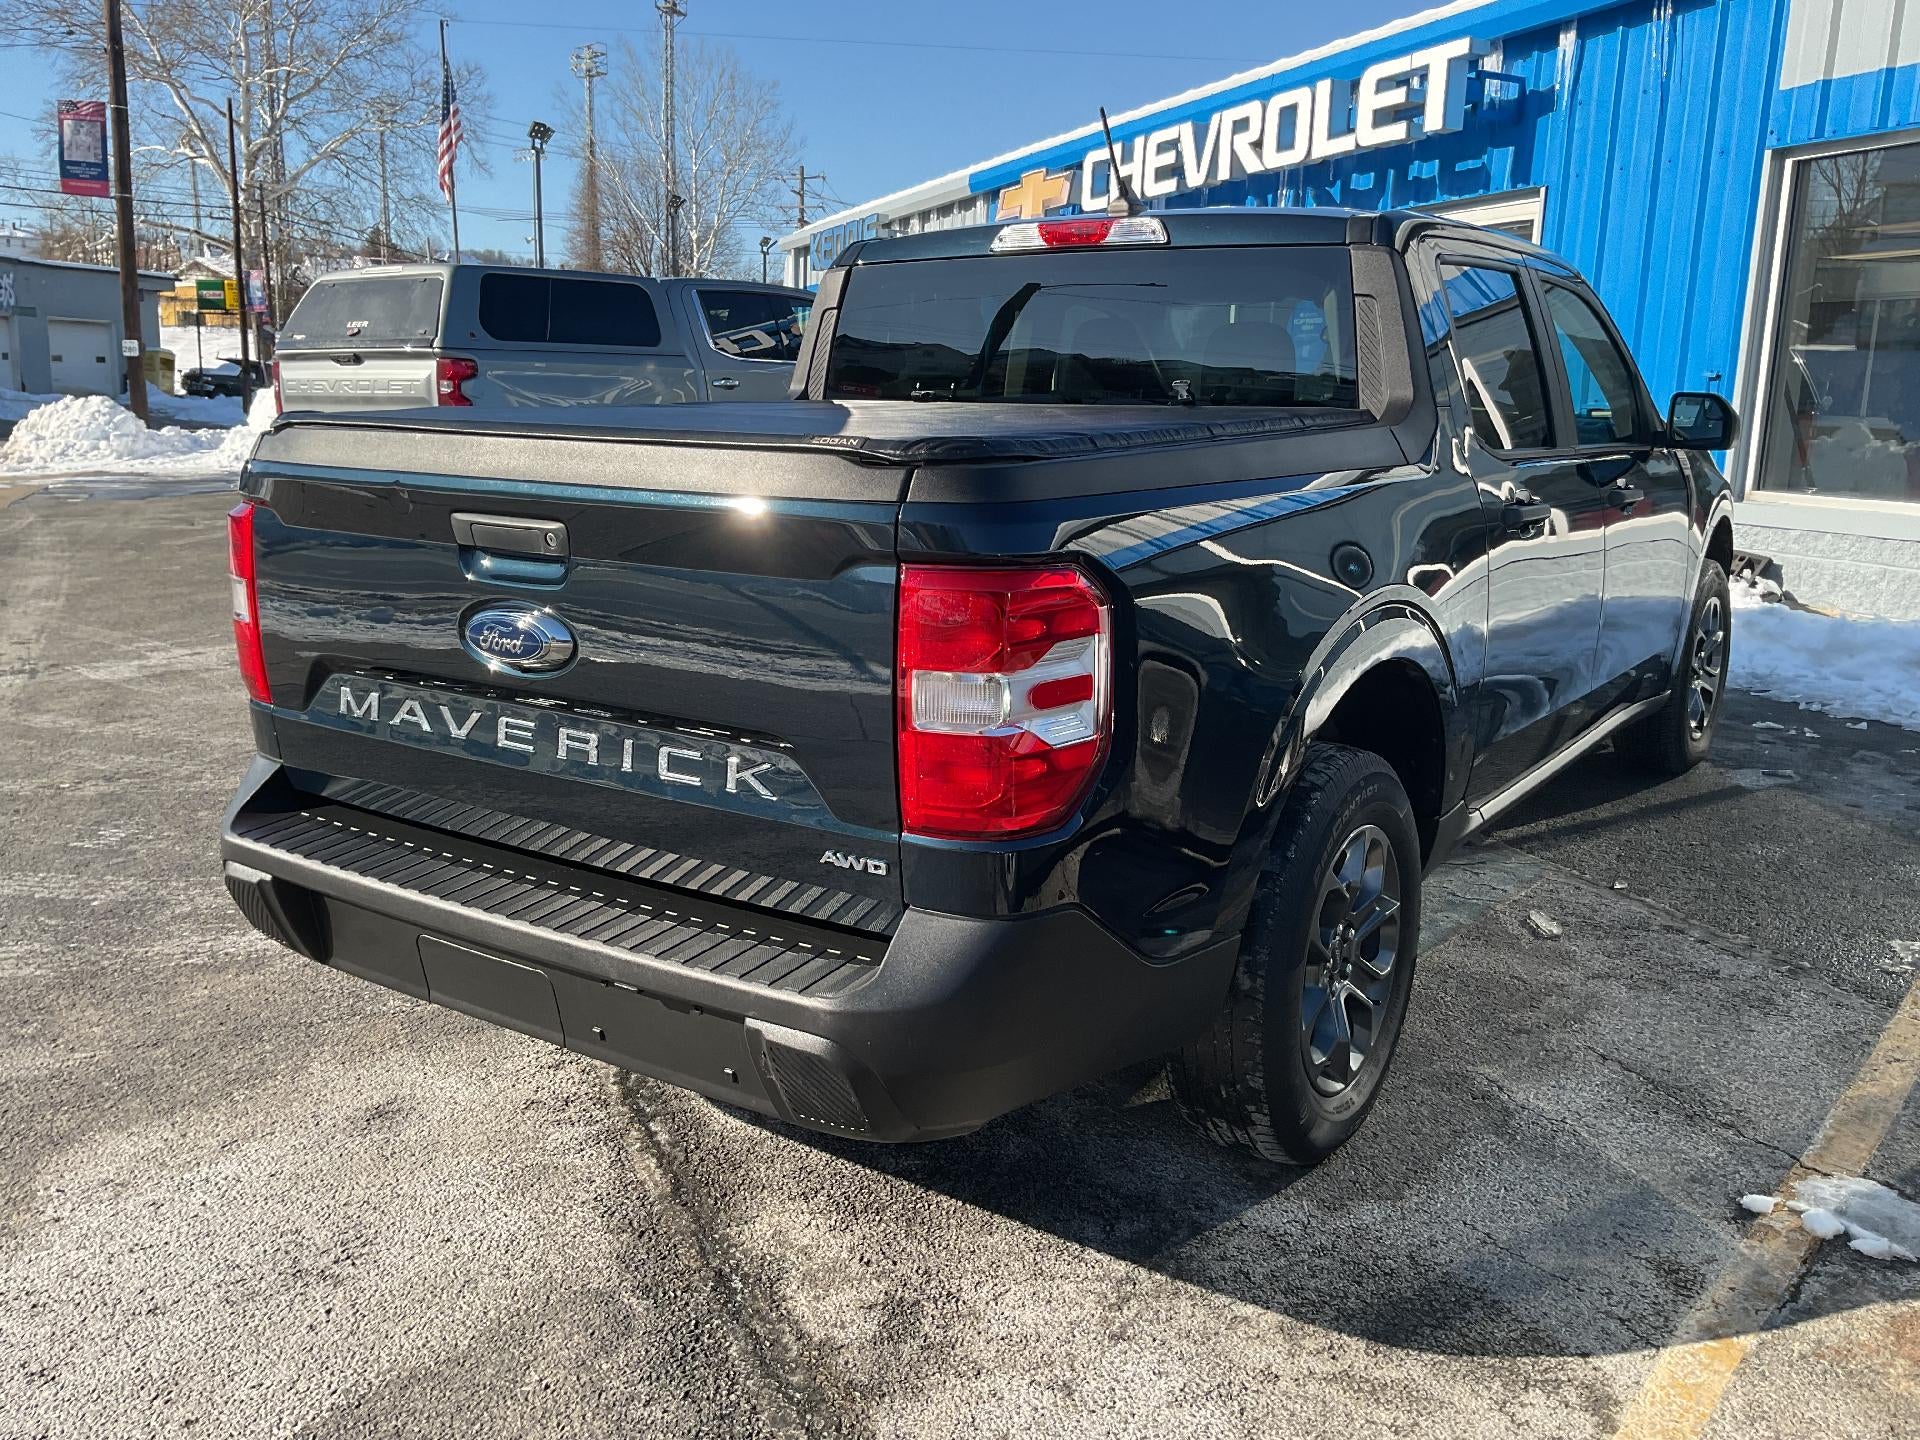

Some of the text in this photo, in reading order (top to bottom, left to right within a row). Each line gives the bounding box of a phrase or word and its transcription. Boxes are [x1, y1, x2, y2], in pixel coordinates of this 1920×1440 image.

[1082, 37, 1474, 212] CHEVROLET
[346, 320, 369, 328] LEER
[286, 379, 421, 394] CHEVROLET
[480, 622, 524, 654] Ford
[339, 685, 778, 801] MAVERICK
[819, 849, 889, 876] AWD
